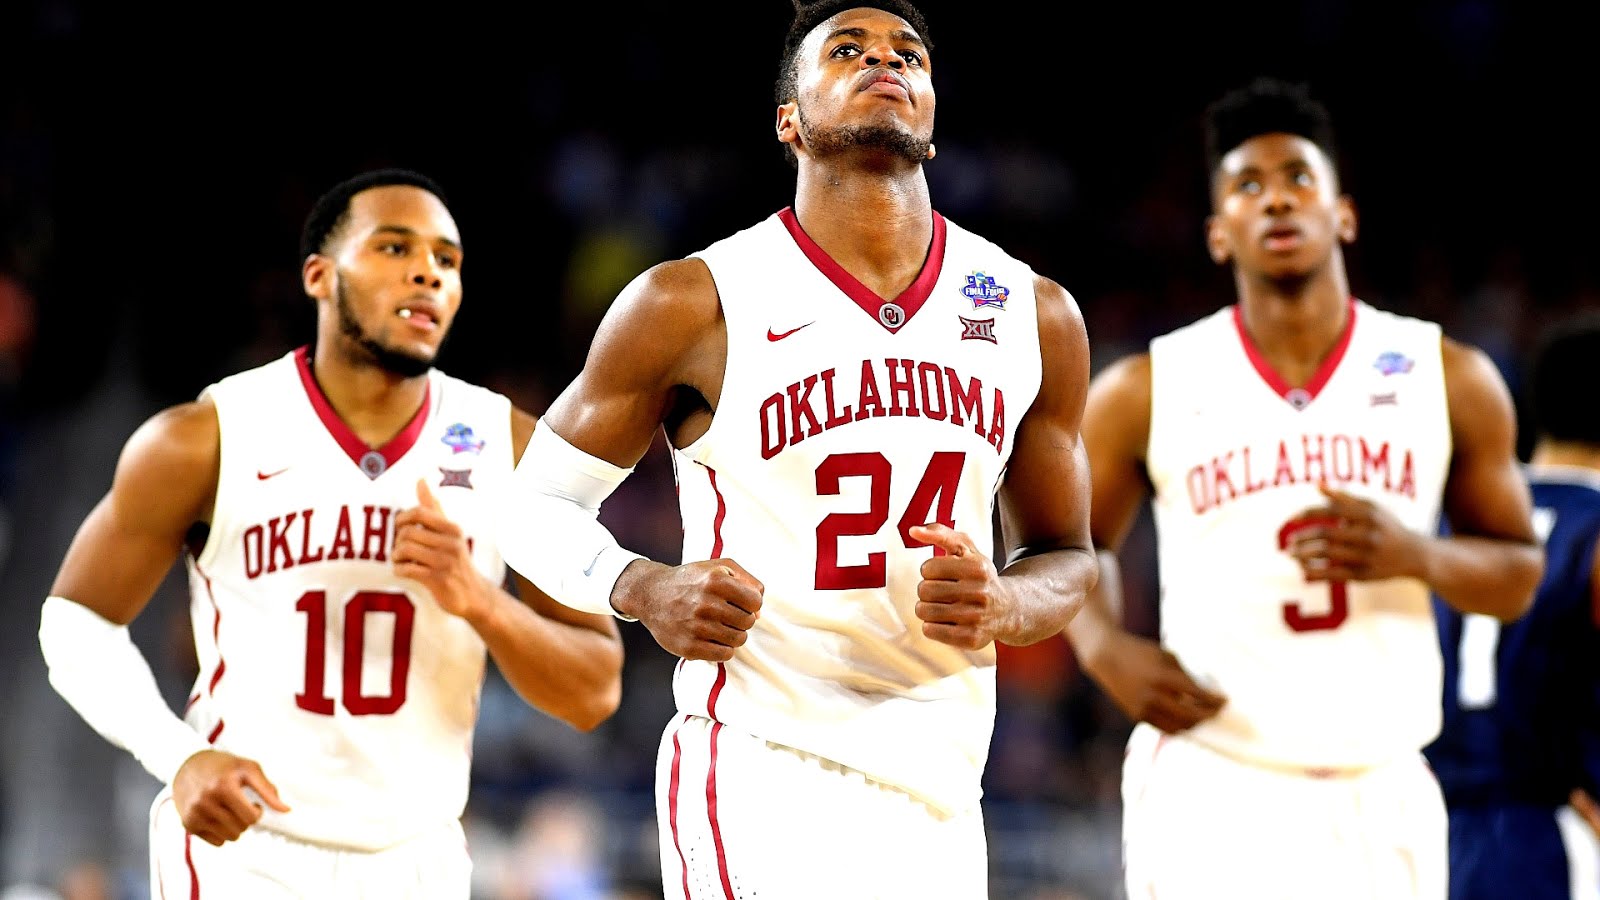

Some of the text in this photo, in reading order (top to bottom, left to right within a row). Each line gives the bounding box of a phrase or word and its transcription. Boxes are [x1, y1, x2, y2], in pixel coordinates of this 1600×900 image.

[884, 307, 899, 325] OU
[759, 358, 1005, 460] OKLAHOMA
[814, 451, 966, 590] 24
[1187, 435, 1417, 515] OKLAHOMA
[243, 505, 474, 580] OKLAH
[295, 590, 415, 716] 10
